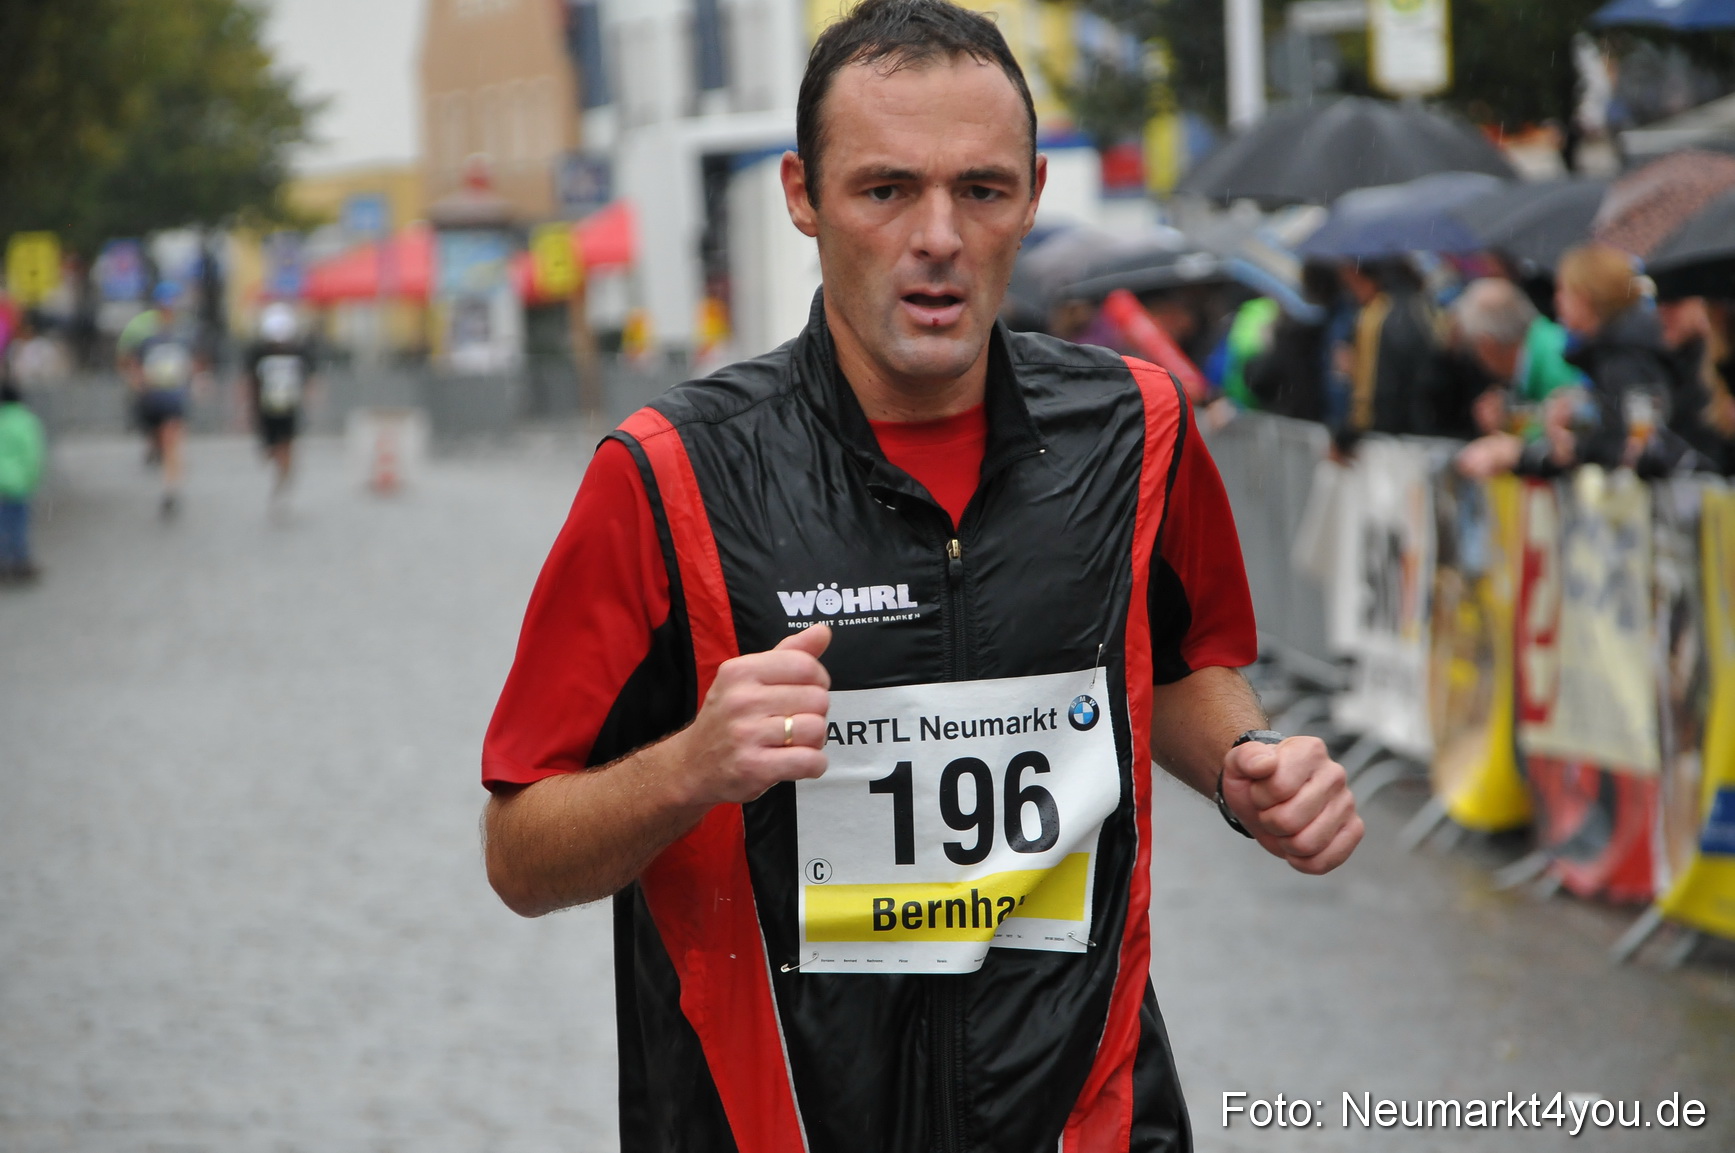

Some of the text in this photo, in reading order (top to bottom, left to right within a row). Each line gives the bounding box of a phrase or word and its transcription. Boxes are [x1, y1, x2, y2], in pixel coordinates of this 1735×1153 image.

[777, 582, 918, 616] WÖHRL
[838, 616, 879, 626] STARKEN
[883, 613, 920, 622] MARKEN
[920, 707, 1057, 741] Neumarkt
[869, 750, 1060, 865] 196
[813, 862, 824, 880] C
